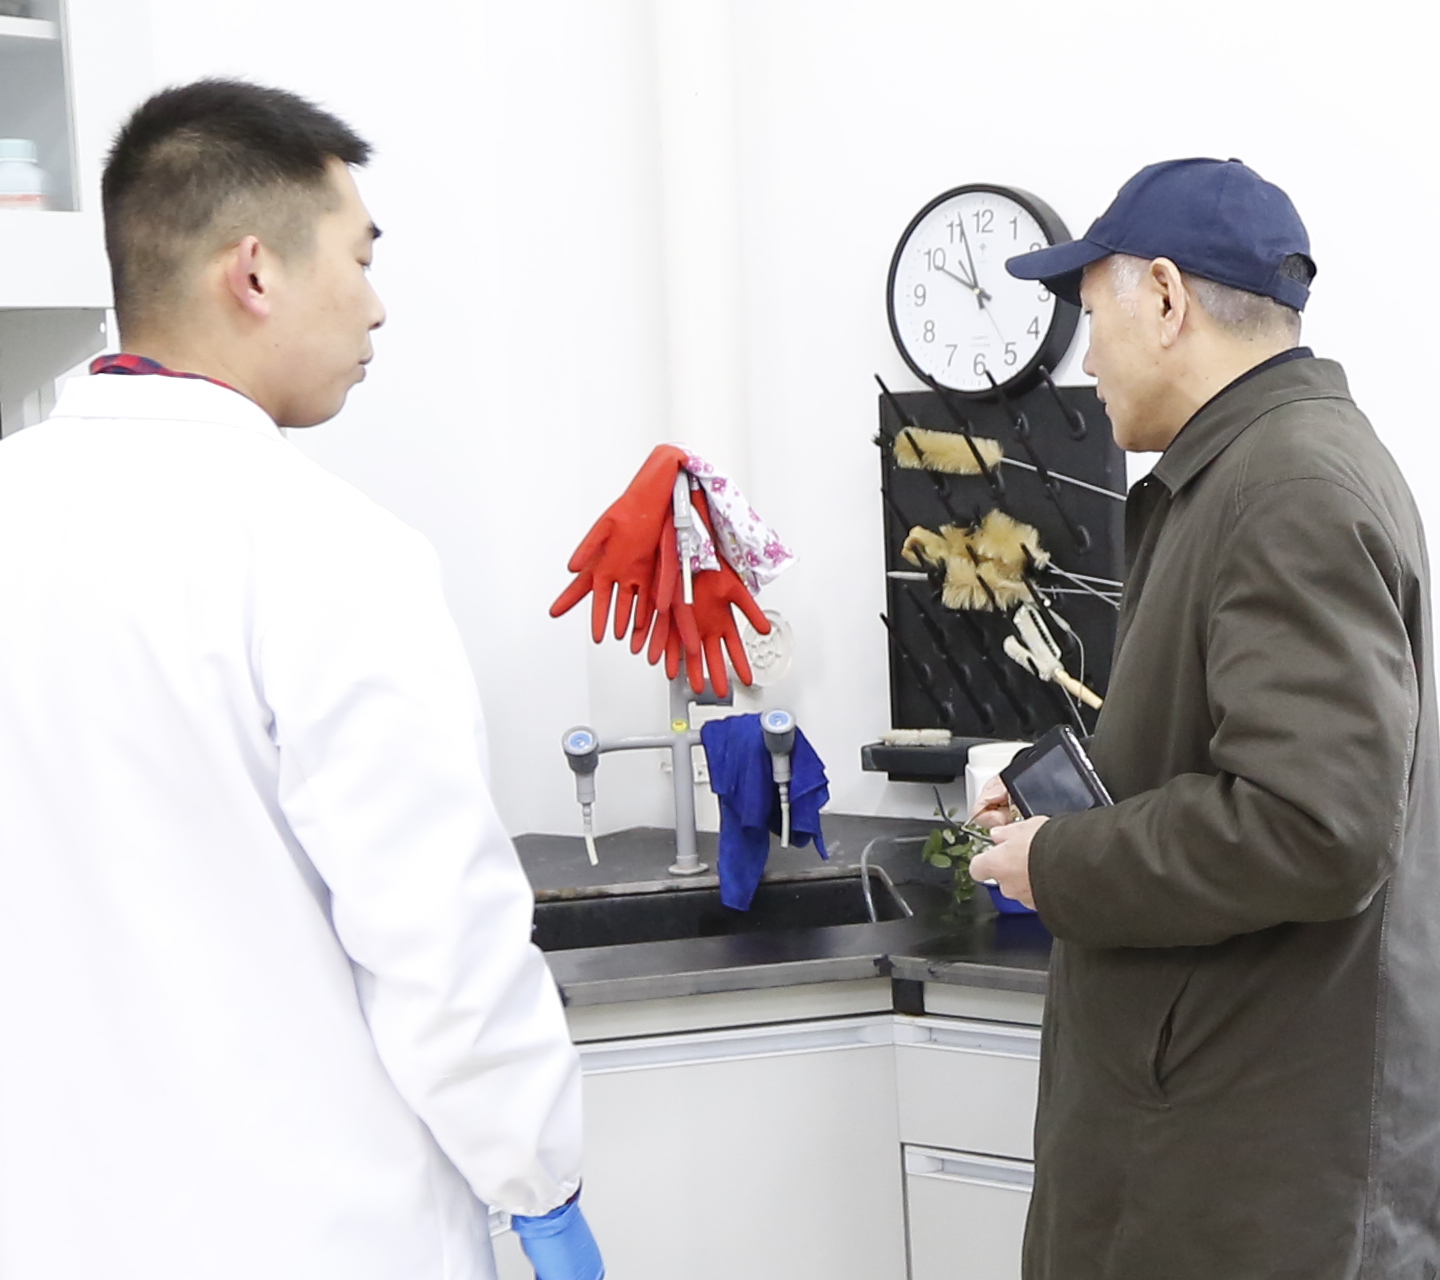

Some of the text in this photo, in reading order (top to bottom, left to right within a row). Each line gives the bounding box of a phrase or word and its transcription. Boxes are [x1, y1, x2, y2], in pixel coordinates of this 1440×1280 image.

[946, 220, 965, 243] 11
[972, 209, 994, 233] 12
[1009, 217, 1018, 240] 1
[924, 248, 947, 272] 10
[914, 284, 927, 307] 9
[1038, 280, 1051, 302] 3
[923, 320, 936, 342] 8
[1027, 316, 1040, 340] 4
[945, 344, 958, 367] 7
[973, 353, 986, 376] 6
[1003, 342, 1018, 366] 5
